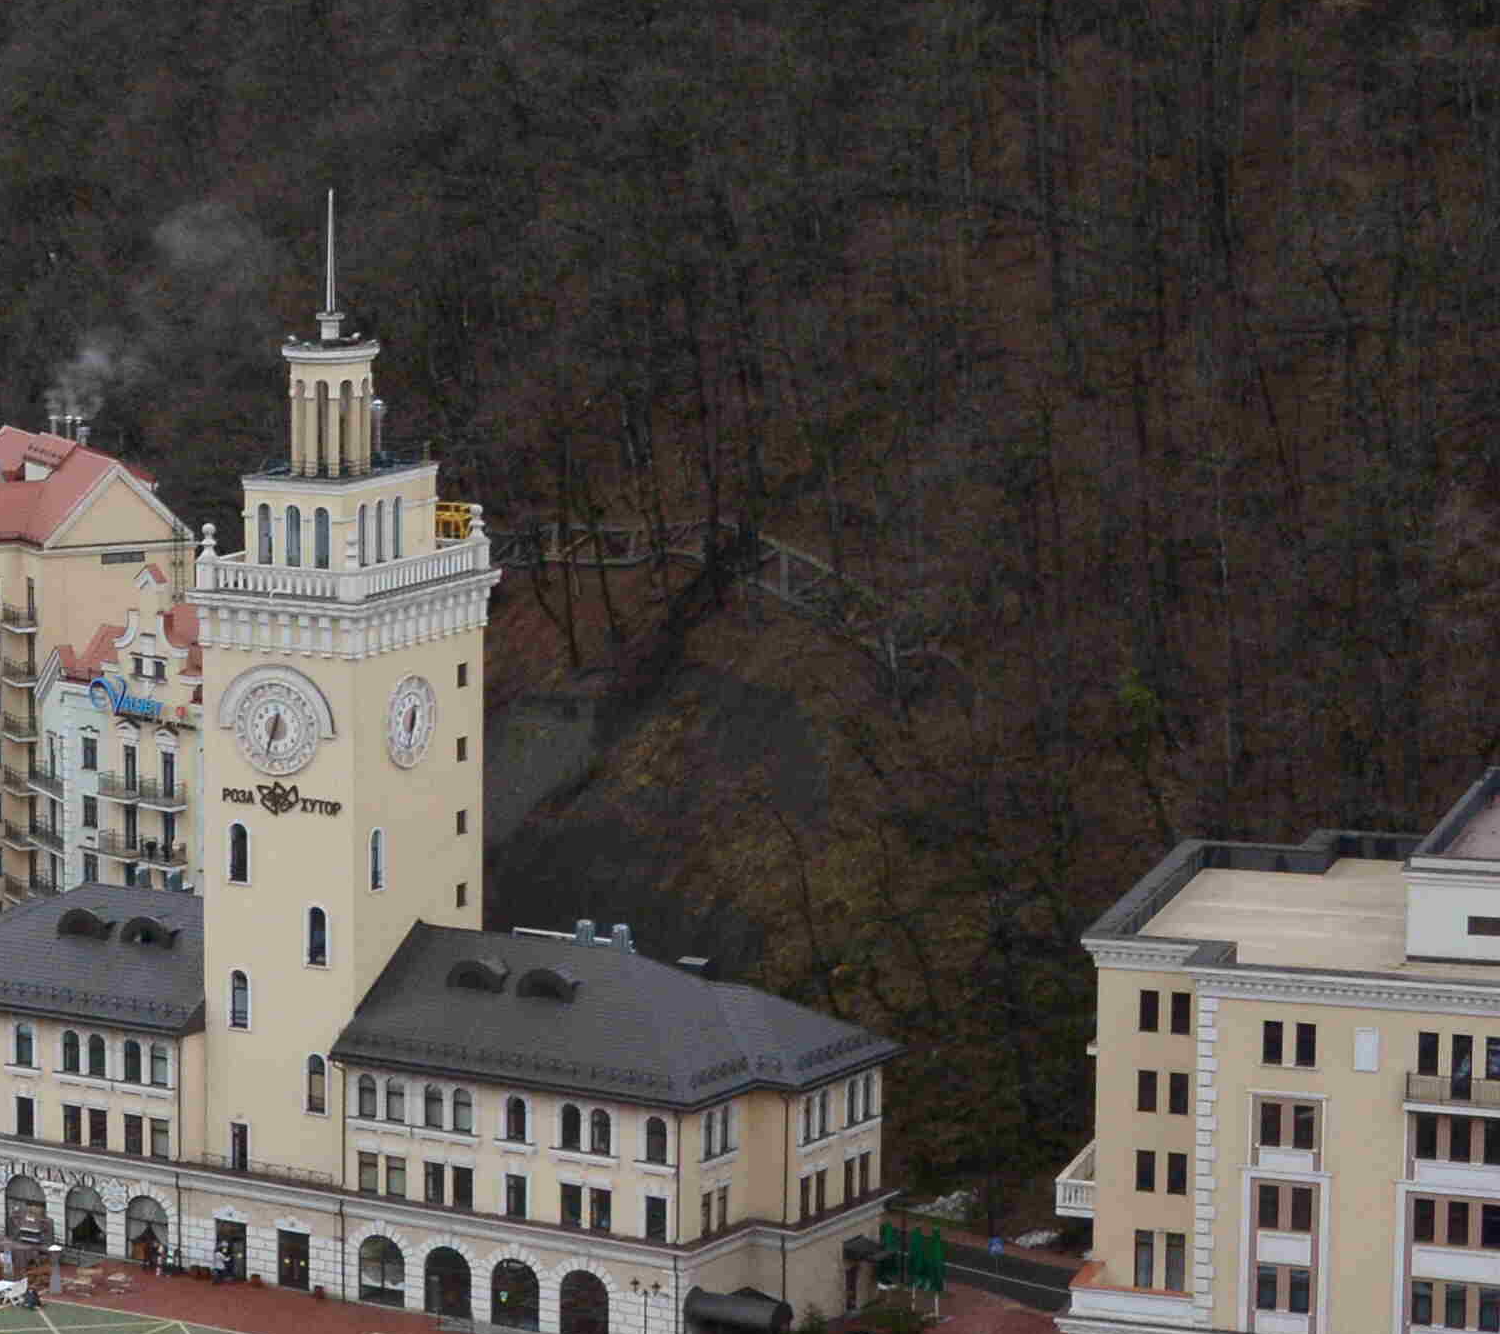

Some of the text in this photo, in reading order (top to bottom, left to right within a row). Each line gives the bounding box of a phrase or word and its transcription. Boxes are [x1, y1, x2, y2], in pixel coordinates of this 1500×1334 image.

[221, 787, 342, 816] РОЗА ХУТОР
[11, 1162, 95, 1188] LUCIANO
